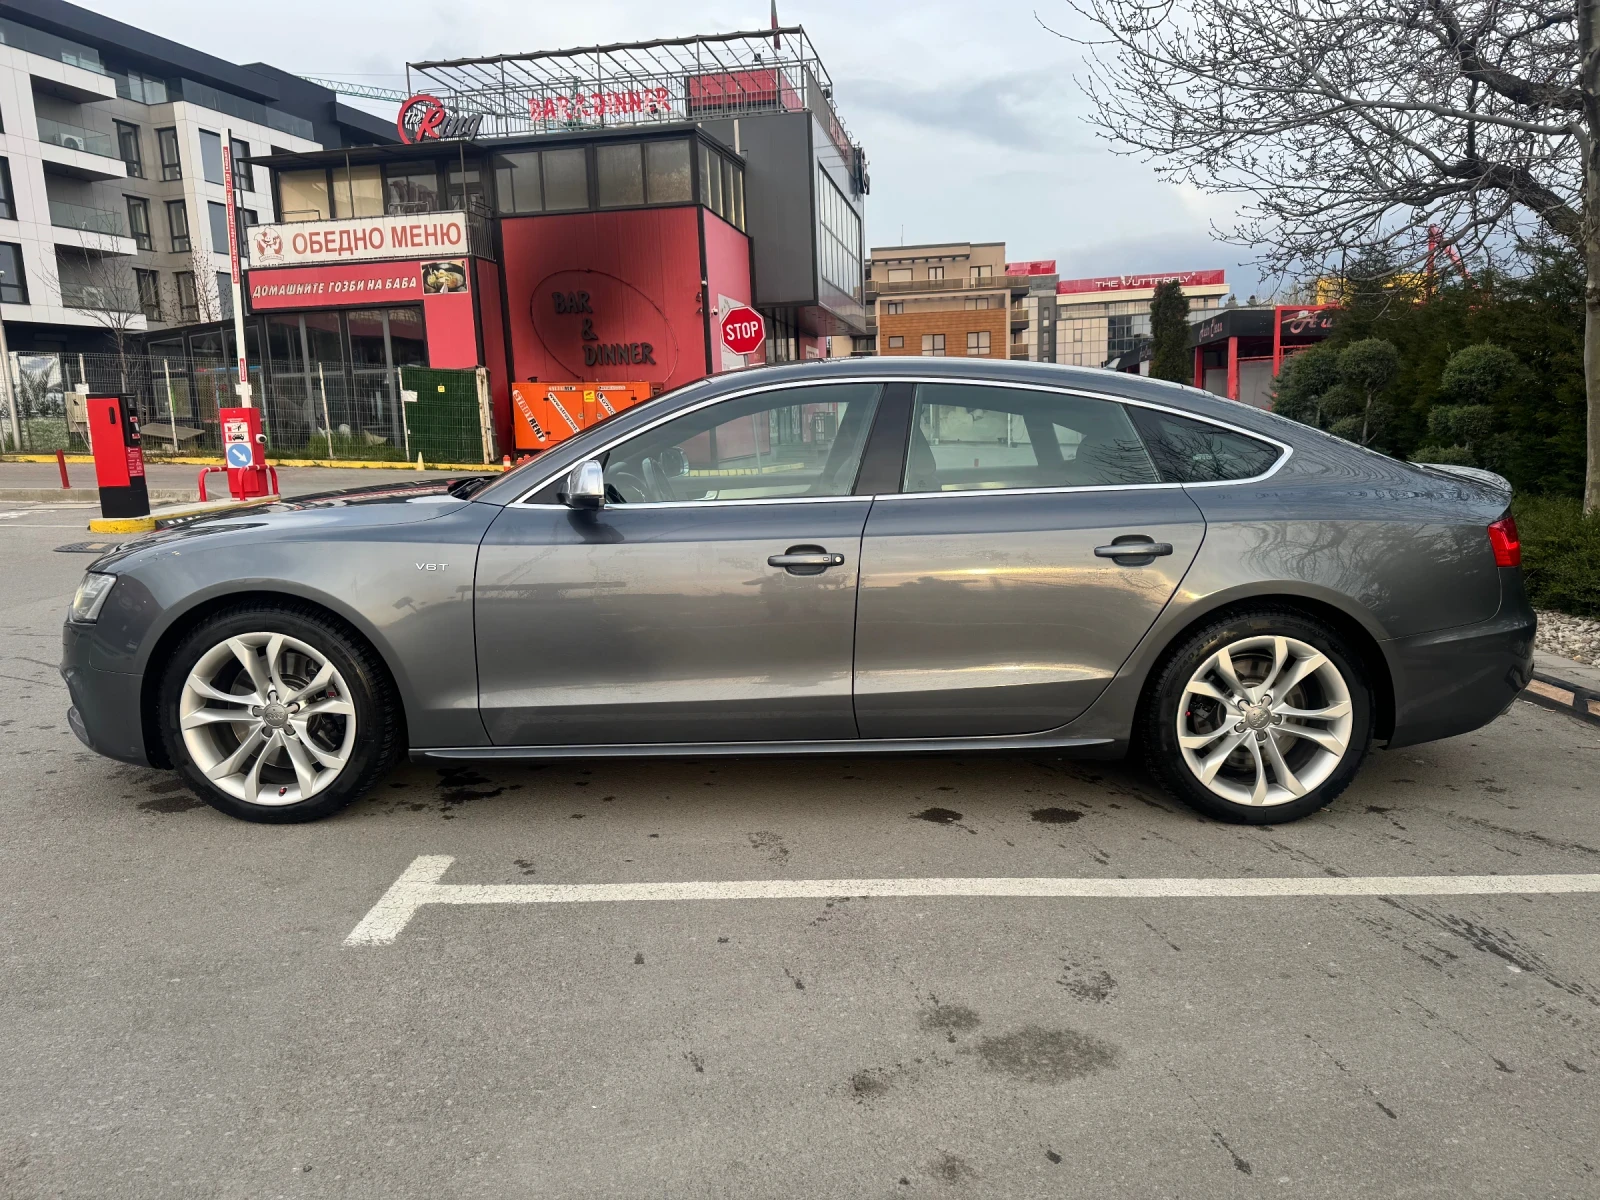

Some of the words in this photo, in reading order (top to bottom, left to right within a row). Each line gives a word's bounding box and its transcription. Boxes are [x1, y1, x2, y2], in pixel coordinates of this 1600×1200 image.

[528, 96, 573, 121] BAR
[574, 93, 591, 119] &
[591, 87, 671, 117] DINNER
[404, 109, 421, 124] The
[413, 105, 483, 142] Ring
[292, 227, 385, 256] ОБЕДНО
[391, 222, 462, 249] МЕНЮ
[252, 282, 324, 298] ДОМАШНИТЕ
[328, 280, 364, 293] ГОЗБИ
[367, 279, 382, 290] НА
[385, 277, 417, 289] БАБА
[1095, 280, 1119, 288] THE
[552, 291, 593, 314] BAR
[581, 318, 598, 340] &
[726, 321, 758, 340] STOP
[1290, 313, 1333, 334] Au
[582, 342, 656, 366] DINNER
[549, 393, 579, 433] www.stroyrent.
[415, 563, 449, 571] V6T
